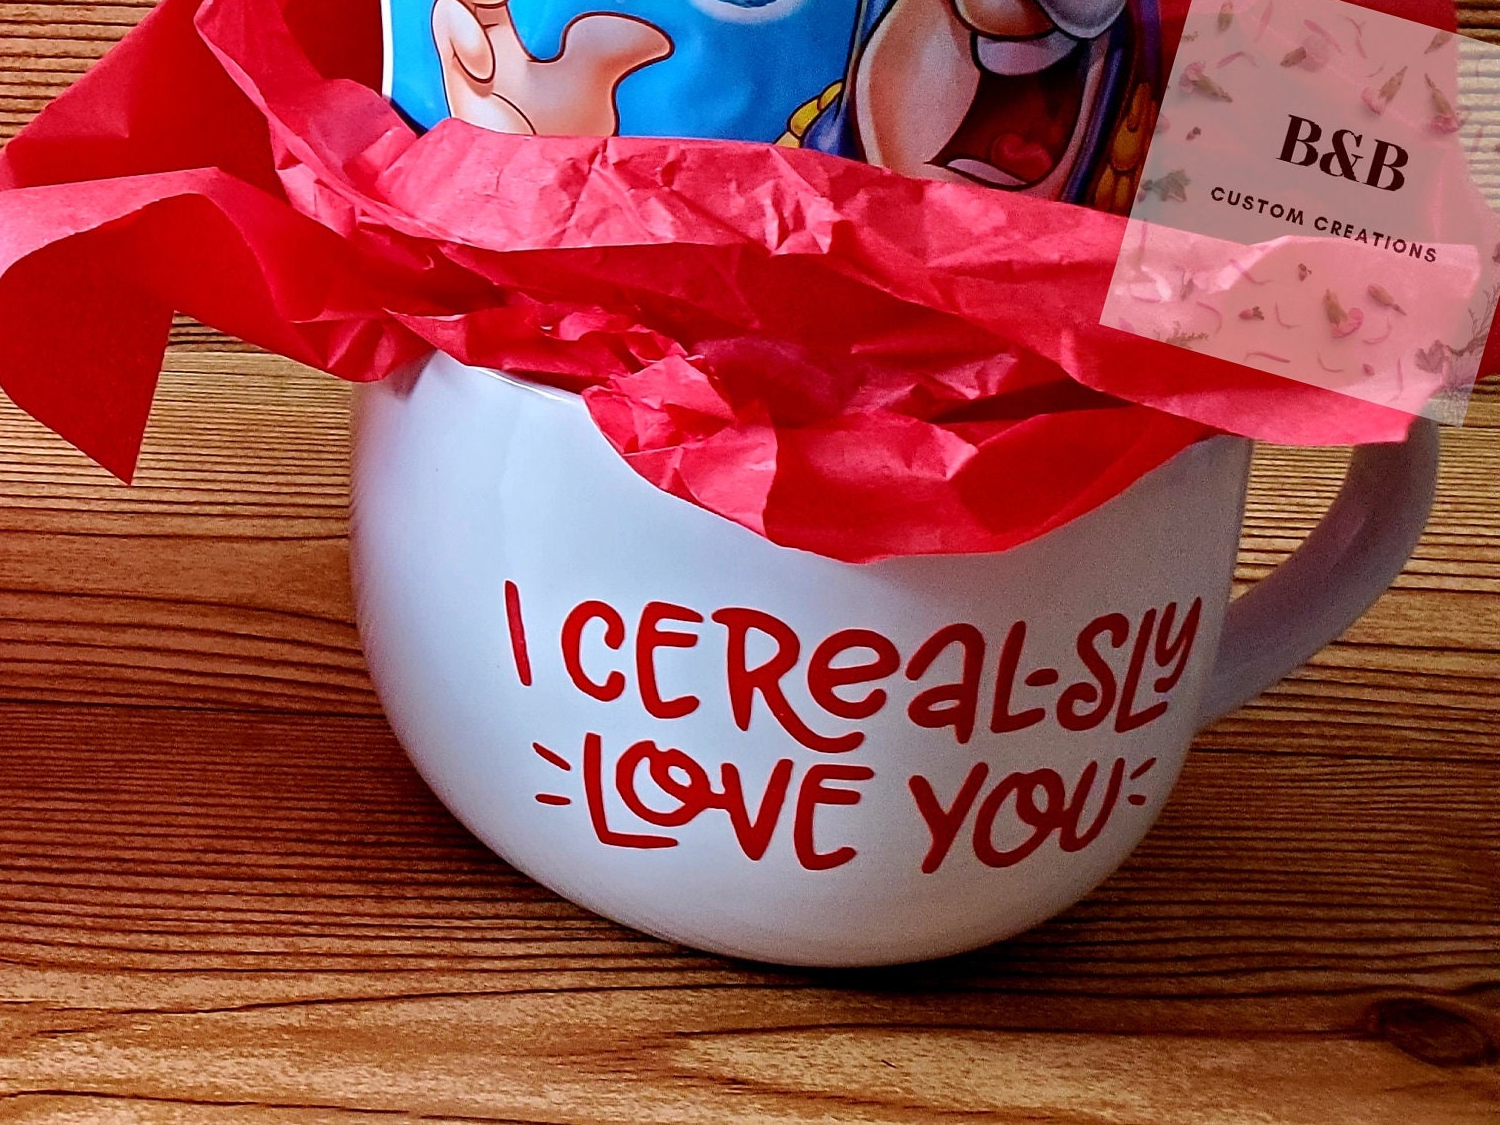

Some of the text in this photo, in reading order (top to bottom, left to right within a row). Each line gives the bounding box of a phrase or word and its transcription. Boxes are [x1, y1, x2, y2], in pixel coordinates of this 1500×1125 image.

[504, 579, 533, 687] I
[582, 732, 1126, 874] LOVE YOU
